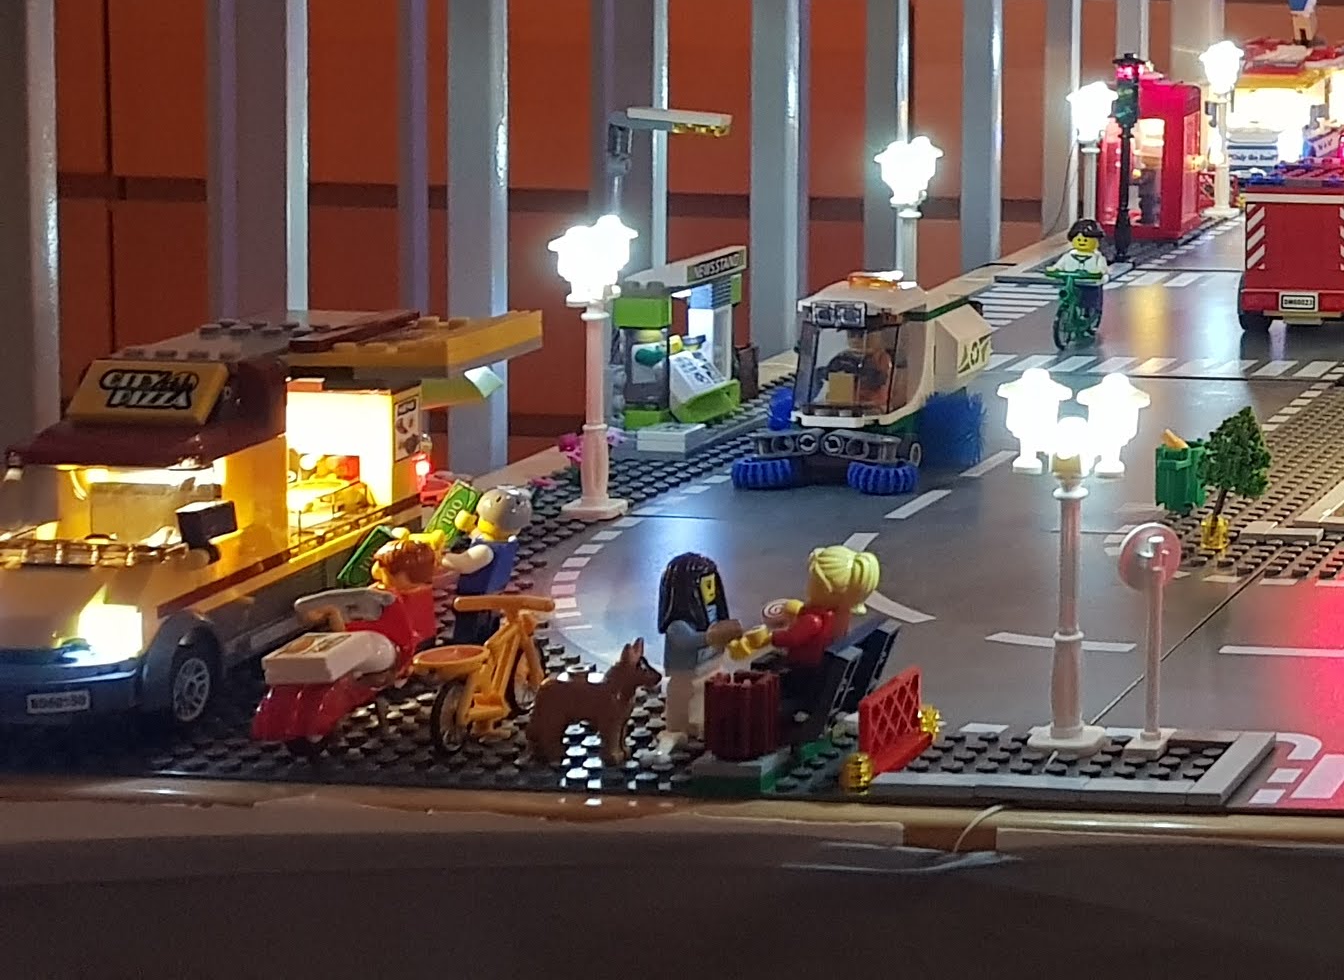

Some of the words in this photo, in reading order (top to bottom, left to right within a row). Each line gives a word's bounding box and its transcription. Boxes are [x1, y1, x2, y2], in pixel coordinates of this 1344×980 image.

[102, 371, 168, 389] CITY
[109, 389, 189, 408] PIZZA
[442, 498, 464, 525] 100
